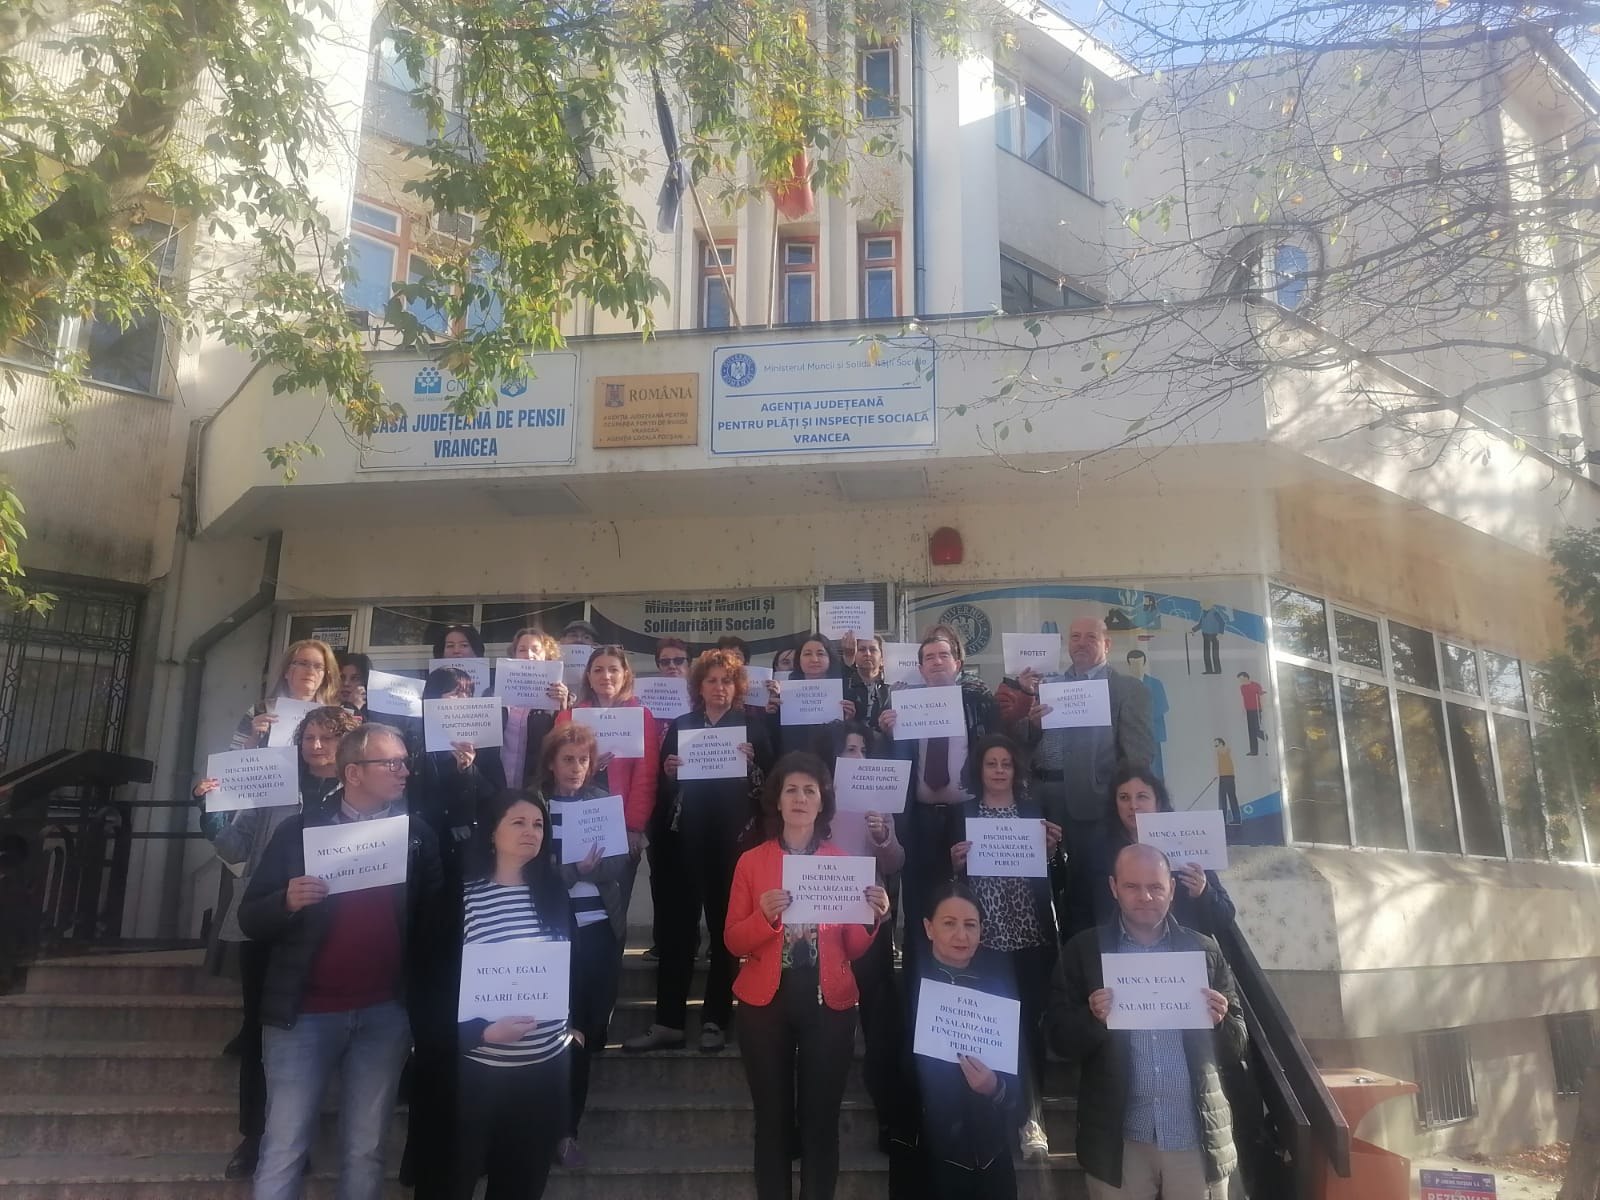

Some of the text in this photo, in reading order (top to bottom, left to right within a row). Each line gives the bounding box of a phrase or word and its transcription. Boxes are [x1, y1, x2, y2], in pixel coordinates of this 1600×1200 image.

[763, 364, 805, 372] Ministerul
[807, 362, 835, 371] Muncii
[629, 385, 692, 402] ROMÂNIA
[761, 396, 884, 413] AGENȚIA JUDEȚEANĂ
[496, 410, 514, 429] DE
[518, 408, 565, 428] PENSII
[717, 420, 764, 431] PENTRU
[766, 417, 799, 431] PLĂȚI
[801, 417, 812, 431] ȘI
[815, 414, 875, 428] INSPECȚIE
[794, 432, 850, 444] VRANCEA
[434, 438, 498, 458] VRANCEA
[644, 599, 713, 613] Ministerul
[714, 596, 761, 612] Muncii
[644, 616, 775, 635] Solidarității Sociale
[901, 720, 927, 728] SALARII
[224, 764, 279, 774] DISCRIMINARE
[857, 765, 880, 773] ACEEASI
[219, 781, 285, 792] FUNCTIONARILOR
[238, 791, 268, 799] PUBLICI
[1180, 829, 1207, 837] EGALA
[316, 840, 387, 857] MUNCA EGALA
[1165, 850, 1182, 858] ARII
[318, 862, 389, 881] SALARII EGALE
[796, 894, 861, 902] FUNCTIONARILOR
[476, 966, 547, 975] MUNCA EGALA
[1116, 976, 1186, 985] MUNCA EGALA
[474, 992, 549, 1002] SALARII EGALE
[957, 996, 978, 1008] FARA
[1118, 1002, 1192, 1011] SALARII EGALE
[939, 1004, 998, 1025] DISCRIMINARE
[935, 1015, 1001, 1037] IN SALARIZAREA
[931, 1025, 1003, 1048] FUNCTIONARILOR
[949, 1040, 983, 1054] PUBLICI
